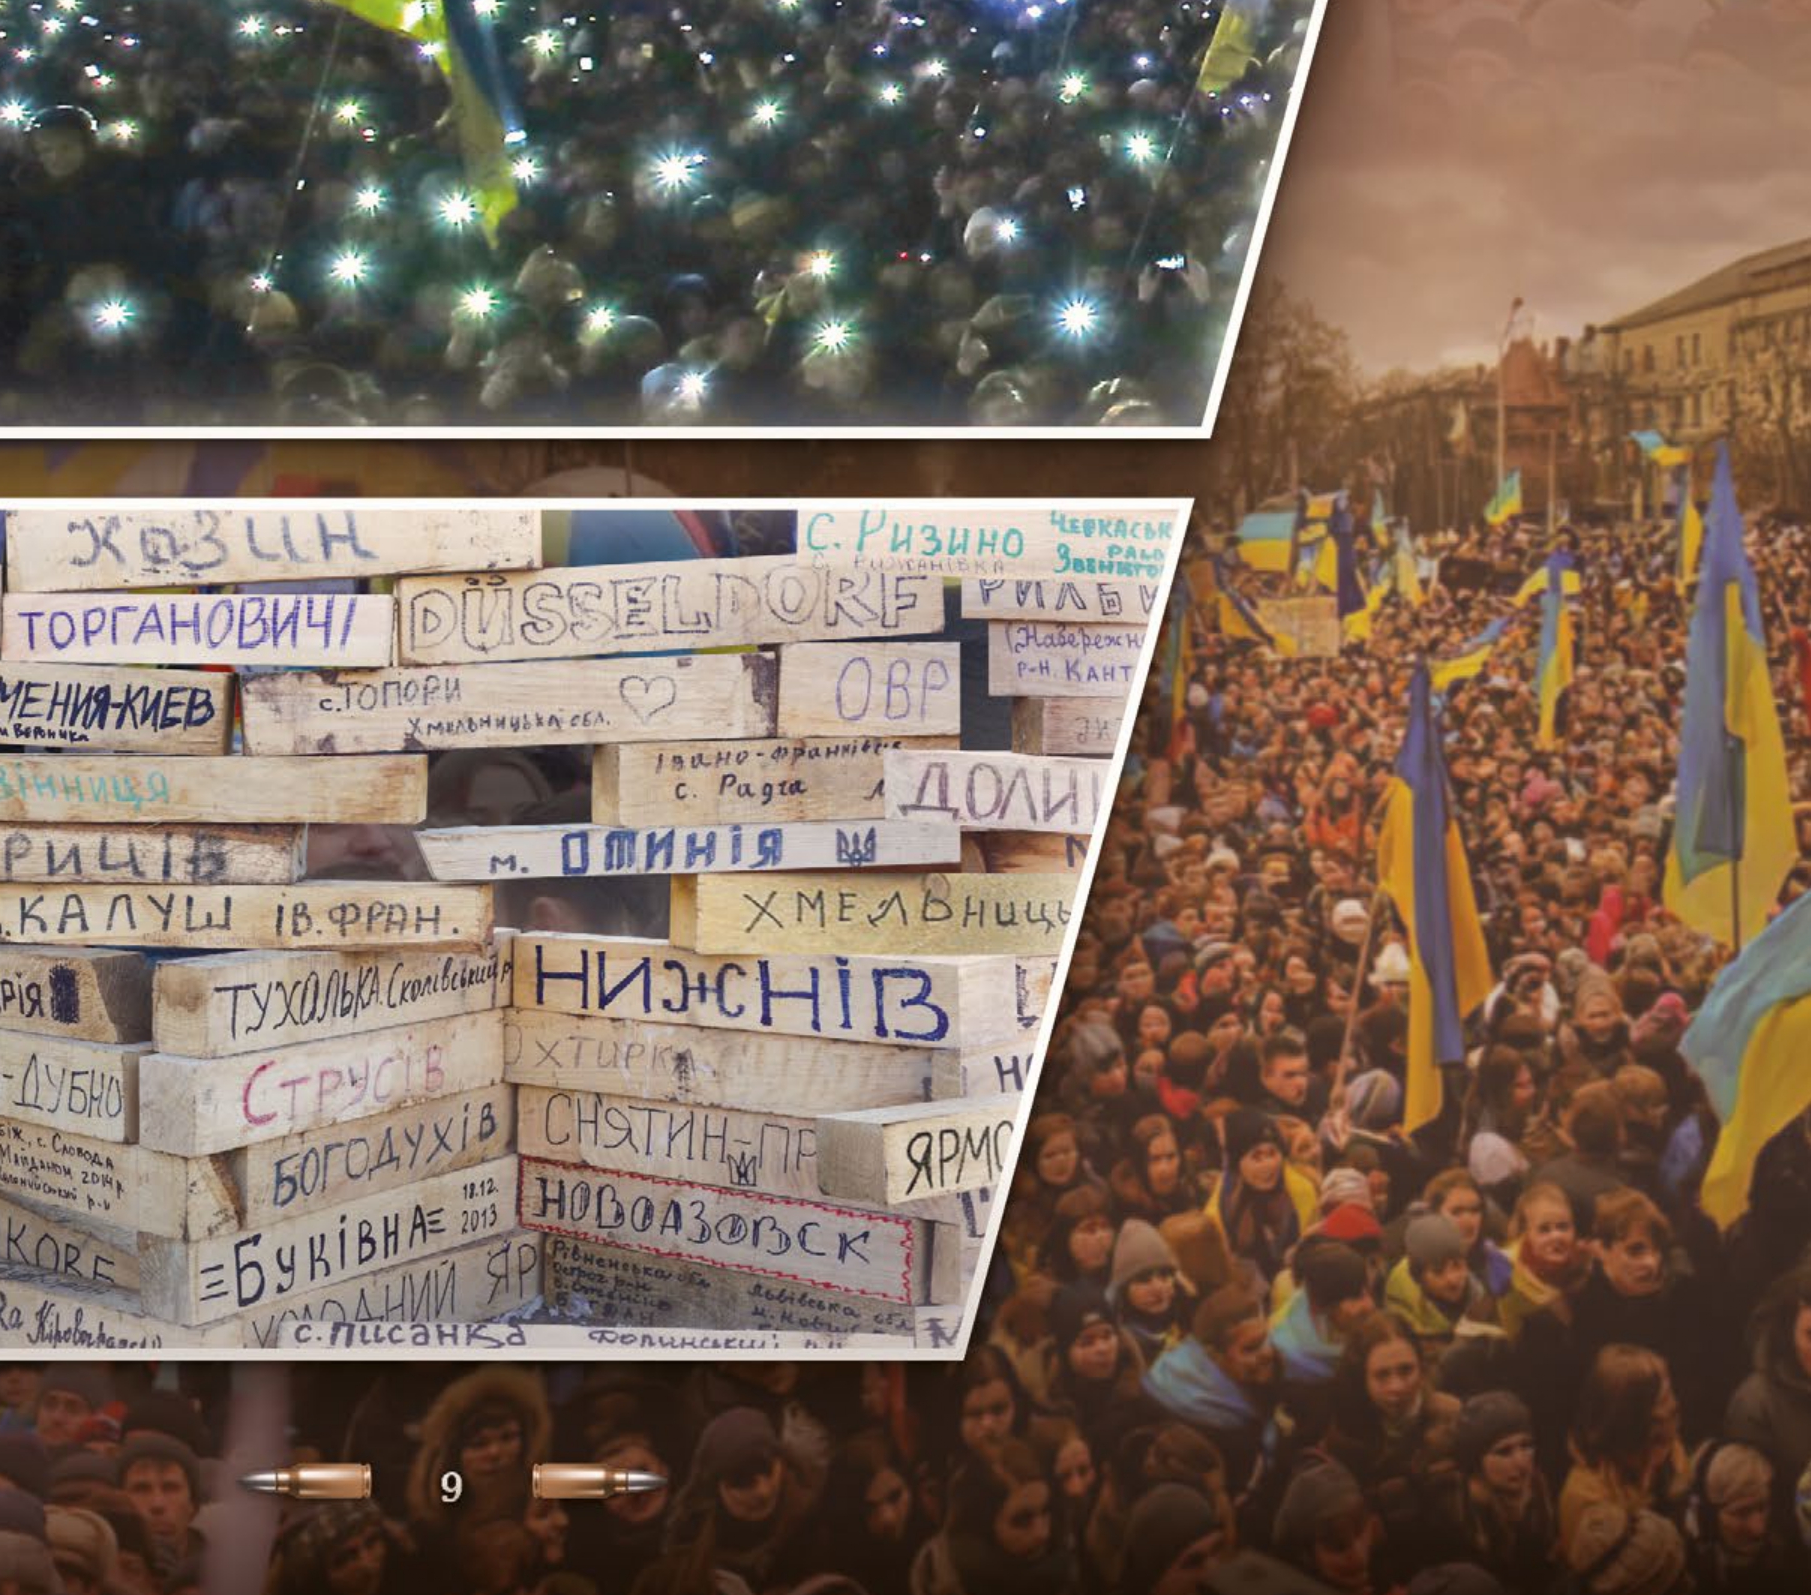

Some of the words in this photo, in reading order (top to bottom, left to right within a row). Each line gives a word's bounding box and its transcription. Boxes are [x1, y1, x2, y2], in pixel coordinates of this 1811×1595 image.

[18, 596, 358, 651] ТОРГАНОВИЧІ
[409, 562, 929, 655] DÜSSELDORF
[18, 893, 232, 935] КАЛУШ
[534, 944, 951, 1042] НИЖНІВ
[460, 1203, 498, 1235] 2013
